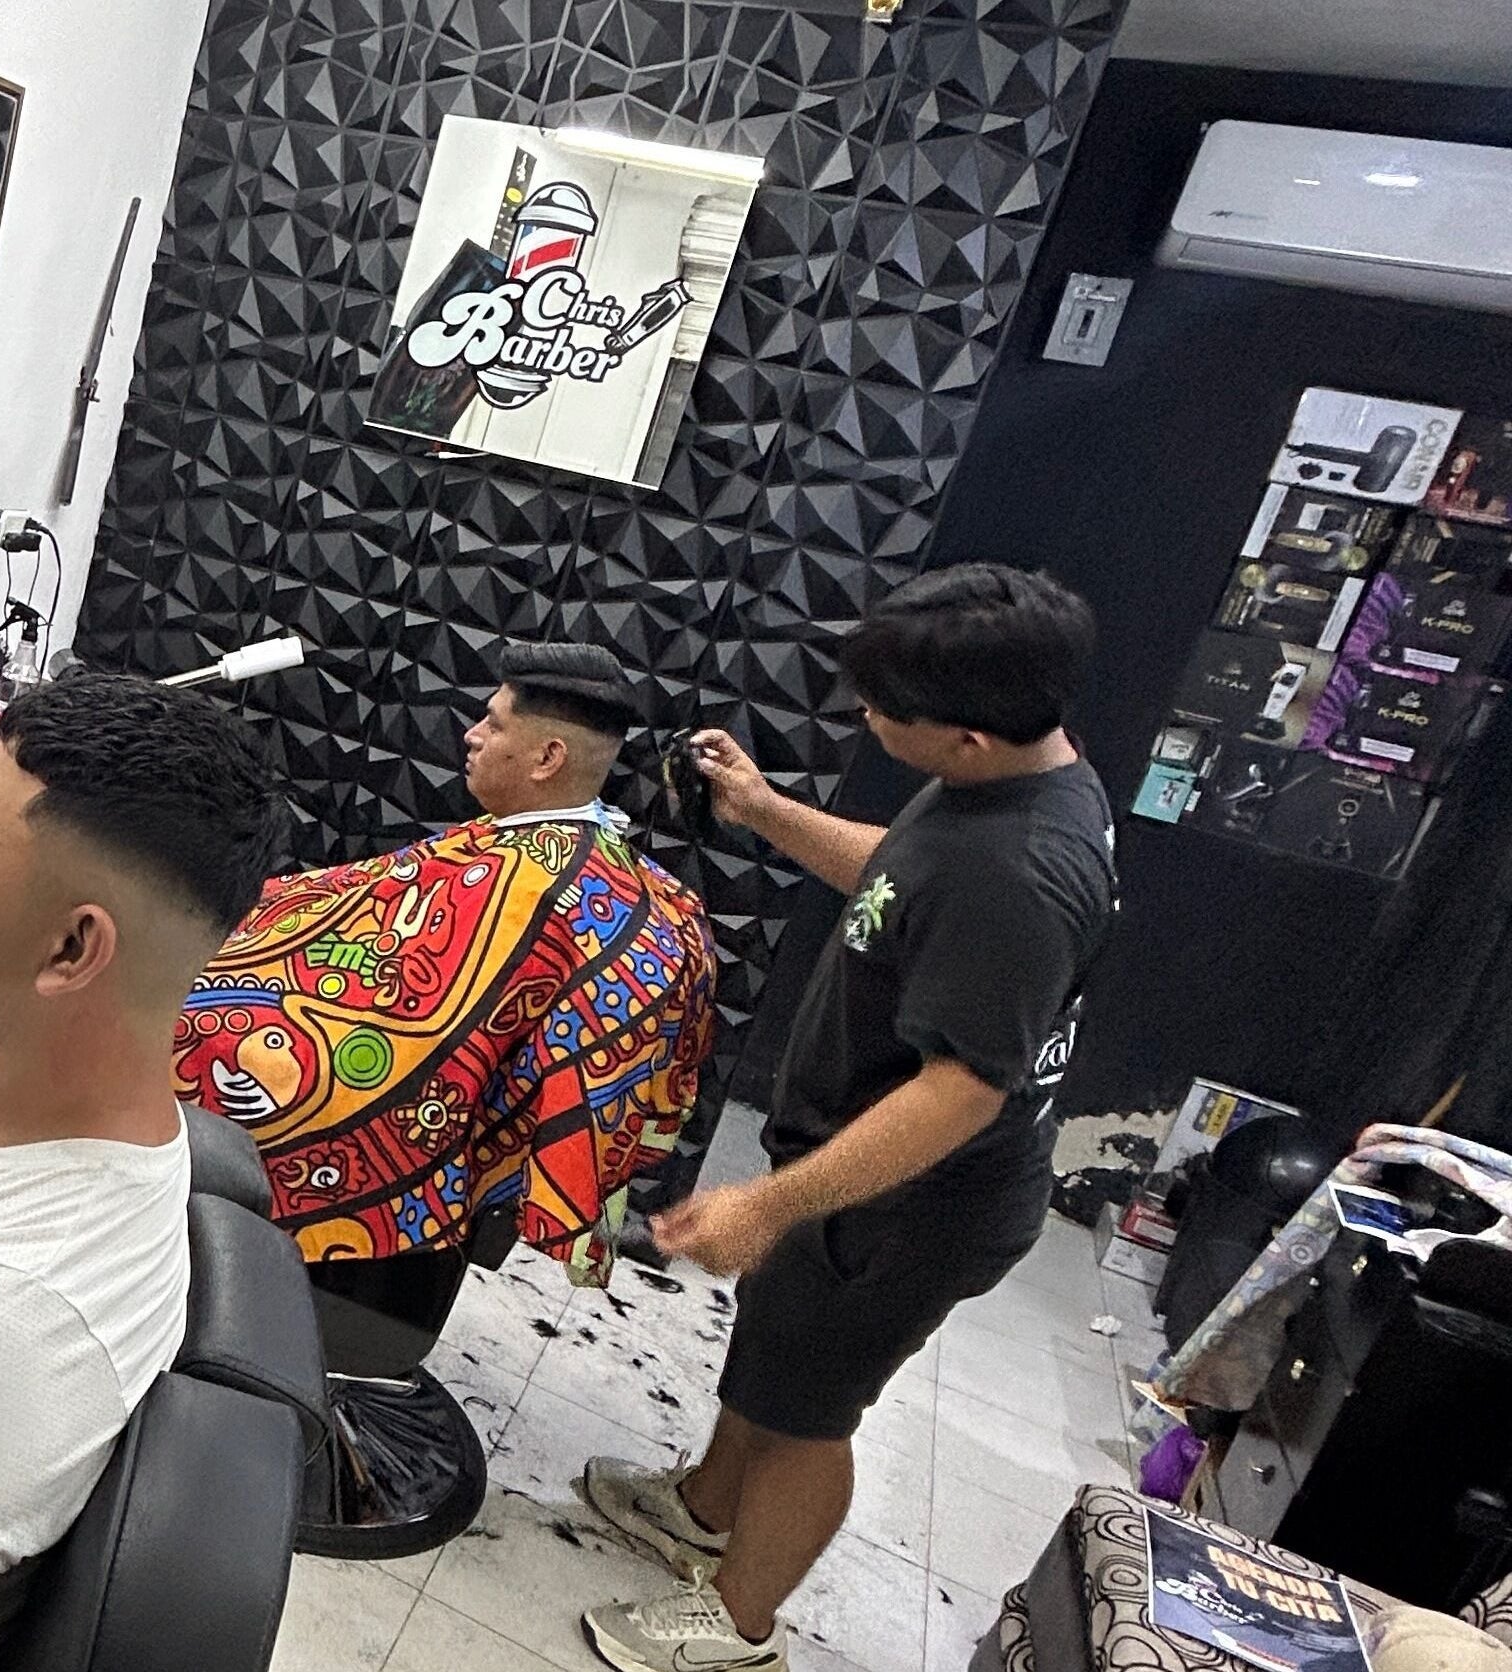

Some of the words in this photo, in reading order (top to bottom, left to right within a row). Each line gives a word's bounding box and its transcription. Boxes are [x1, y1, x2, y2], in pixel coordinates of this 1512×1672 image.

[521, 268, 624, 328] Chris
[407, 282, 620, 381] Barber
[1421, 617, 1475, 635] K-PRO
[1377, 707, 1430, 725] K-PRO
[1207, 1545, 1332, 1601] AGENDA
[1217, 1567, 1260, 1600] TU
[1266, 1591, 1343, 1623] CITA
